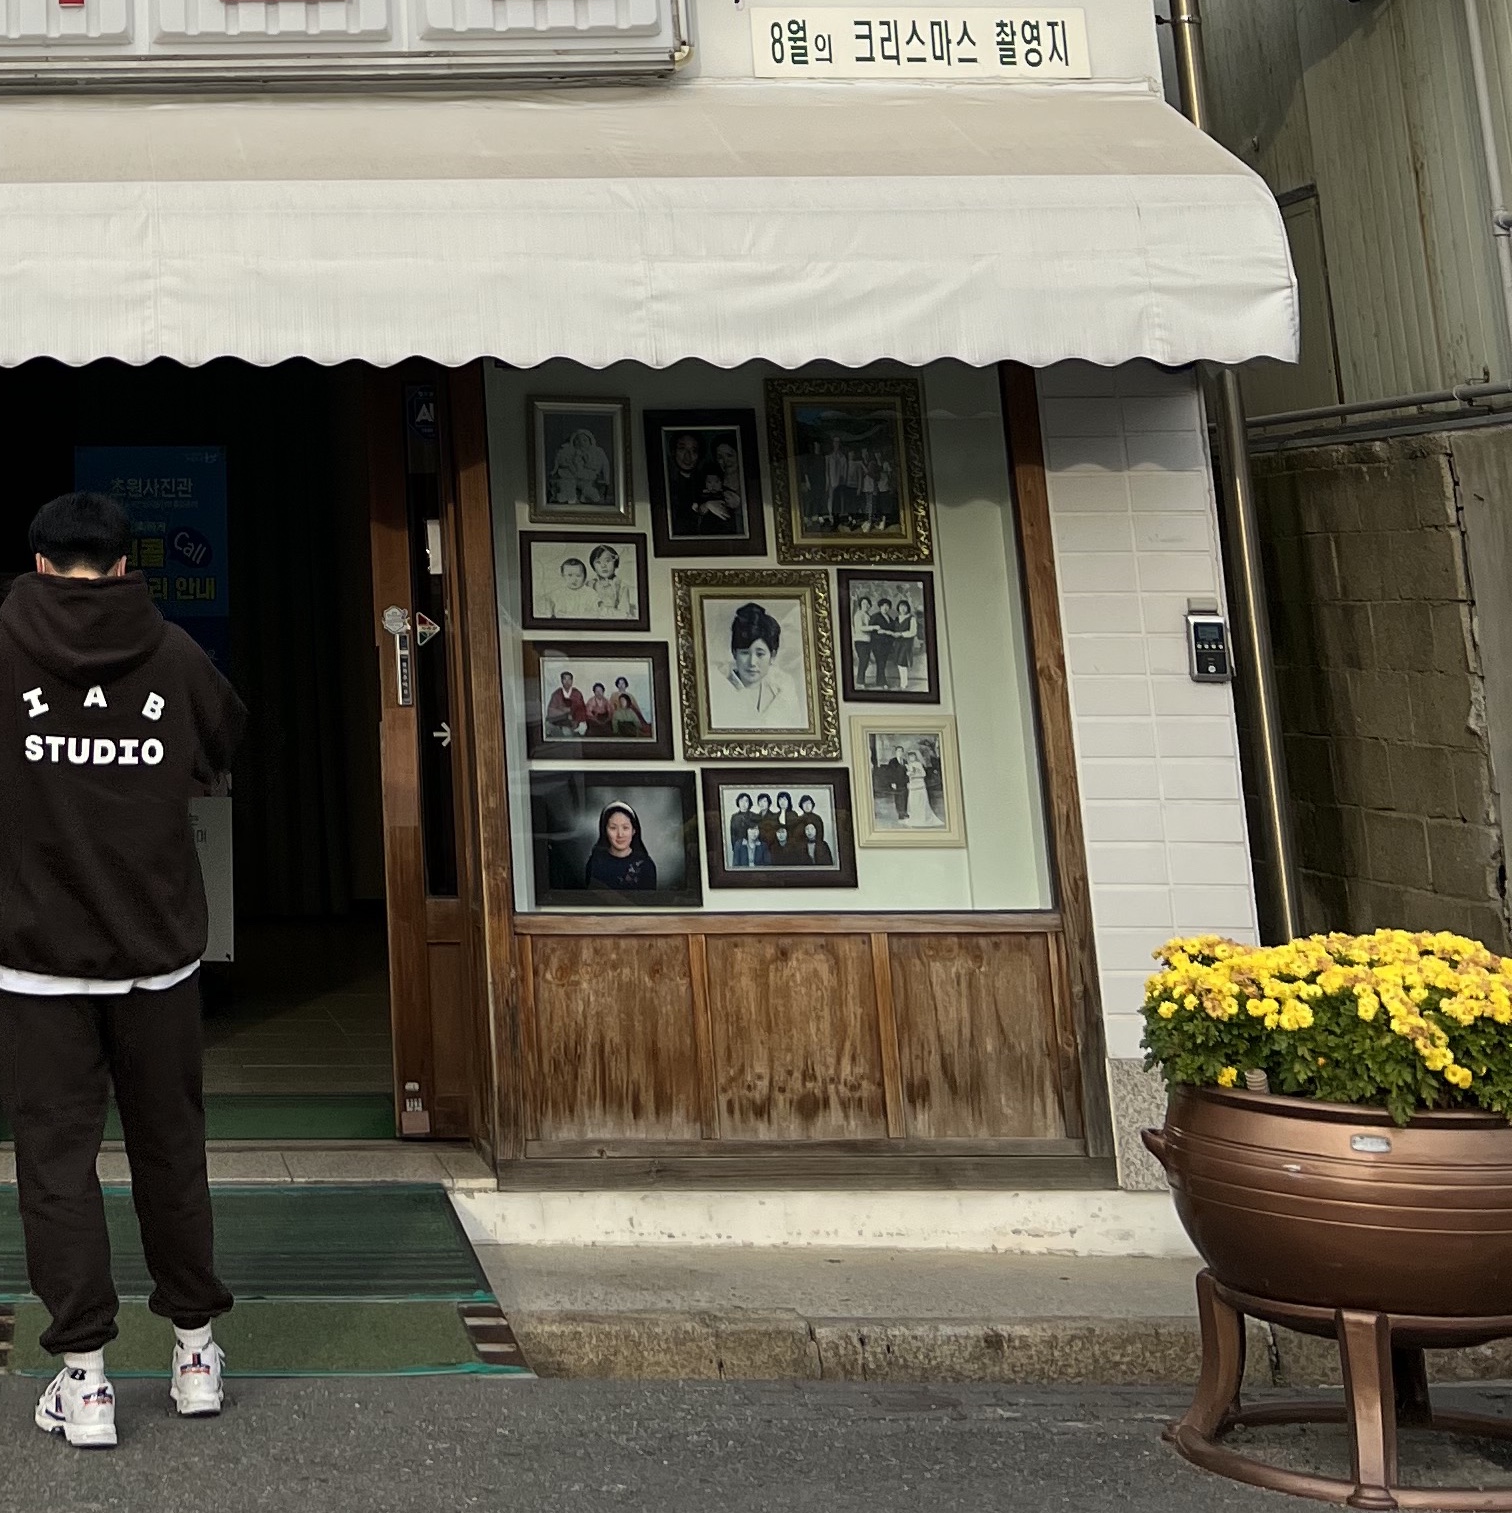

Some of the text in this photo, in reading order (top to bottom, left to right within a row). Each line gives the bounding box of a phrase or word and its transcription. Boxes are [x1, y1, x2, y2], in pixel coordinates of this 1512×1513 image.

[769, 19, 1070, 68] 8월의 크리스마스 촬영지
[174, 531, 207, 564] Call
[24, 734, 164, 765] STUDIO
